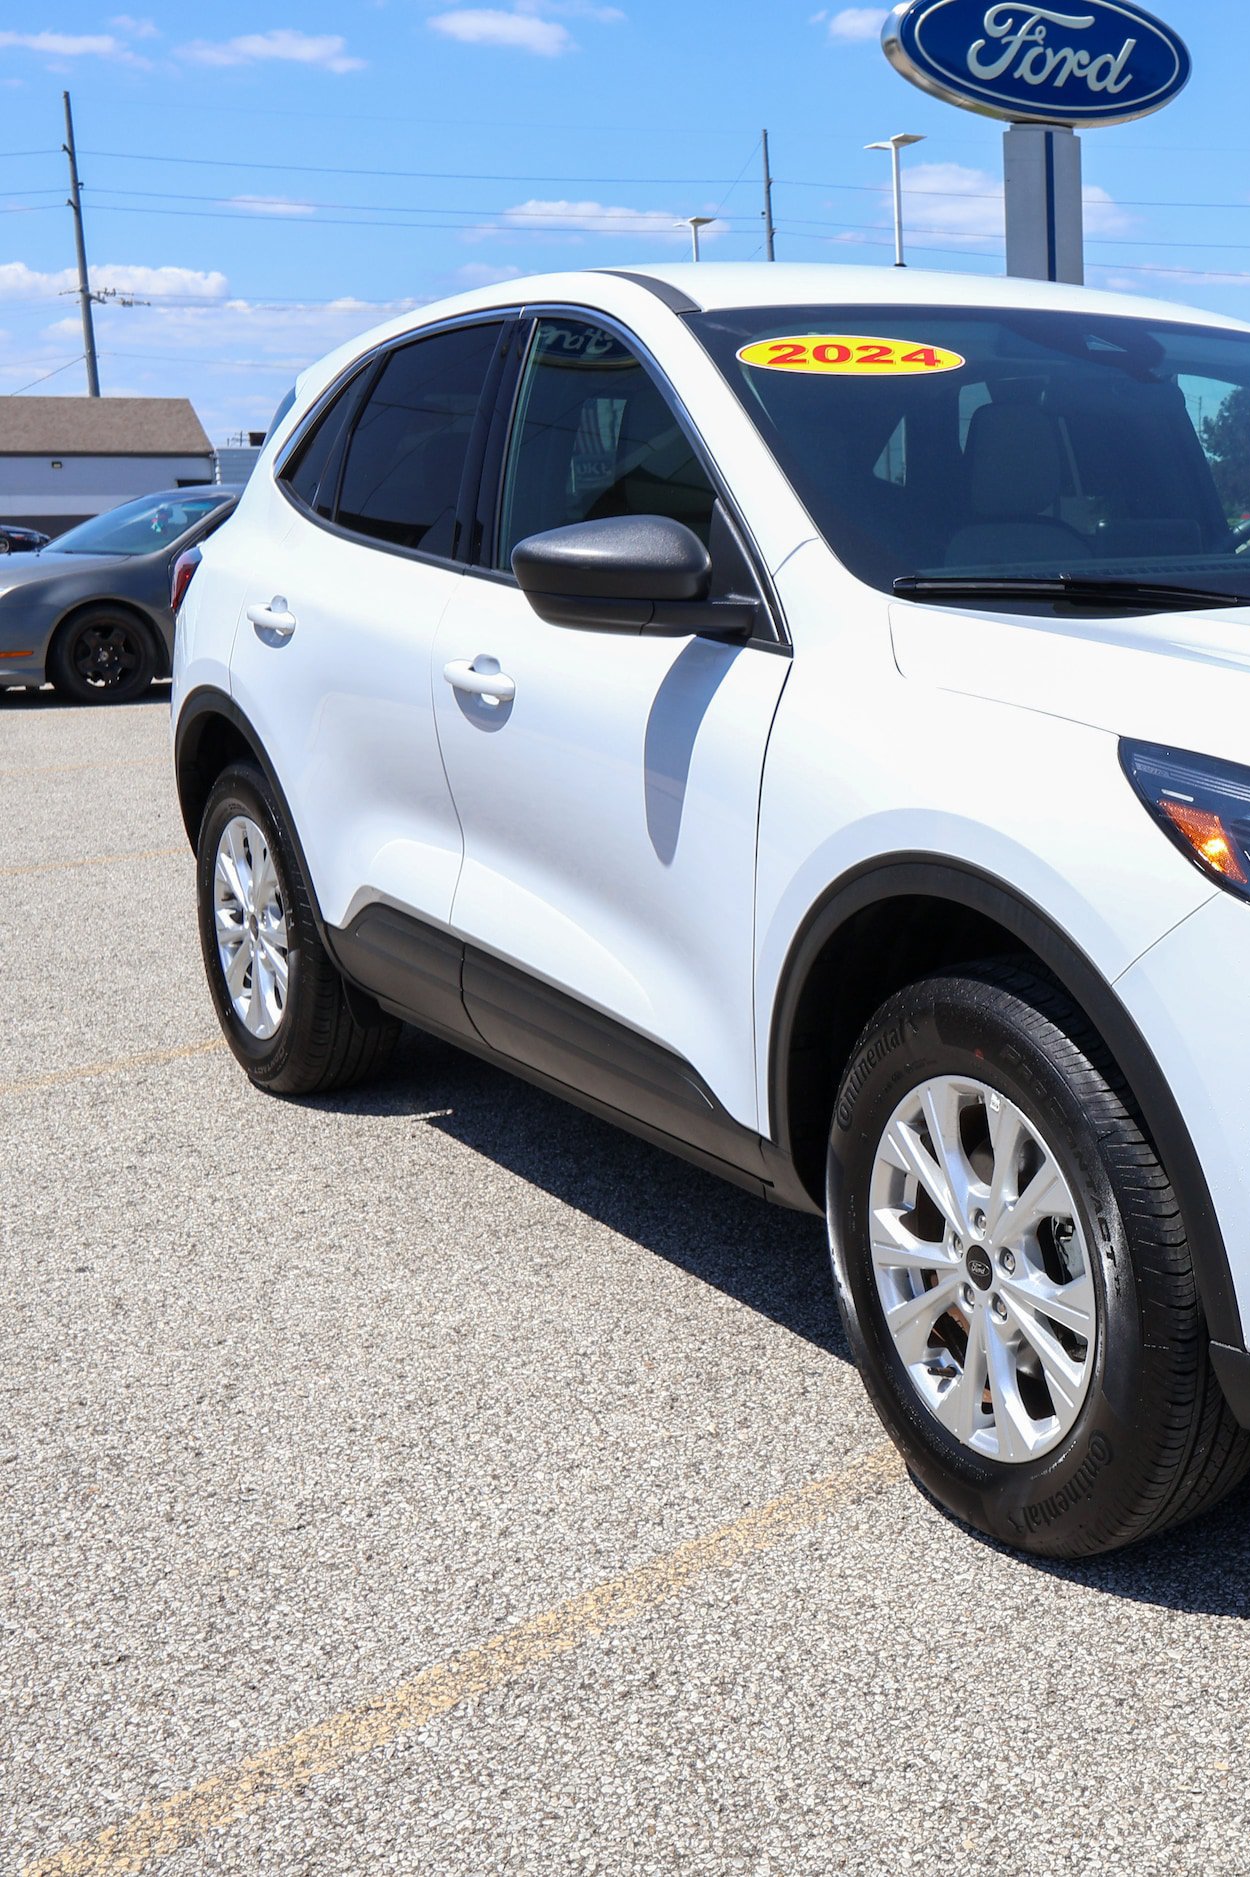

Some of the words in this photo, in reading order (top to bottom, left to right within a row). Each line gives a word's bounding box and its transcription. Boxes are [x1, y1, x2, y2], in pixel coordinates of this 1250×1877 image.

[967, 2, 1134, 94] Ford
[767, 343, 942, 367] 2024
[836, 1020, 907, 1132] Continental
[1022, 1429, 1114, 1533] Continental
